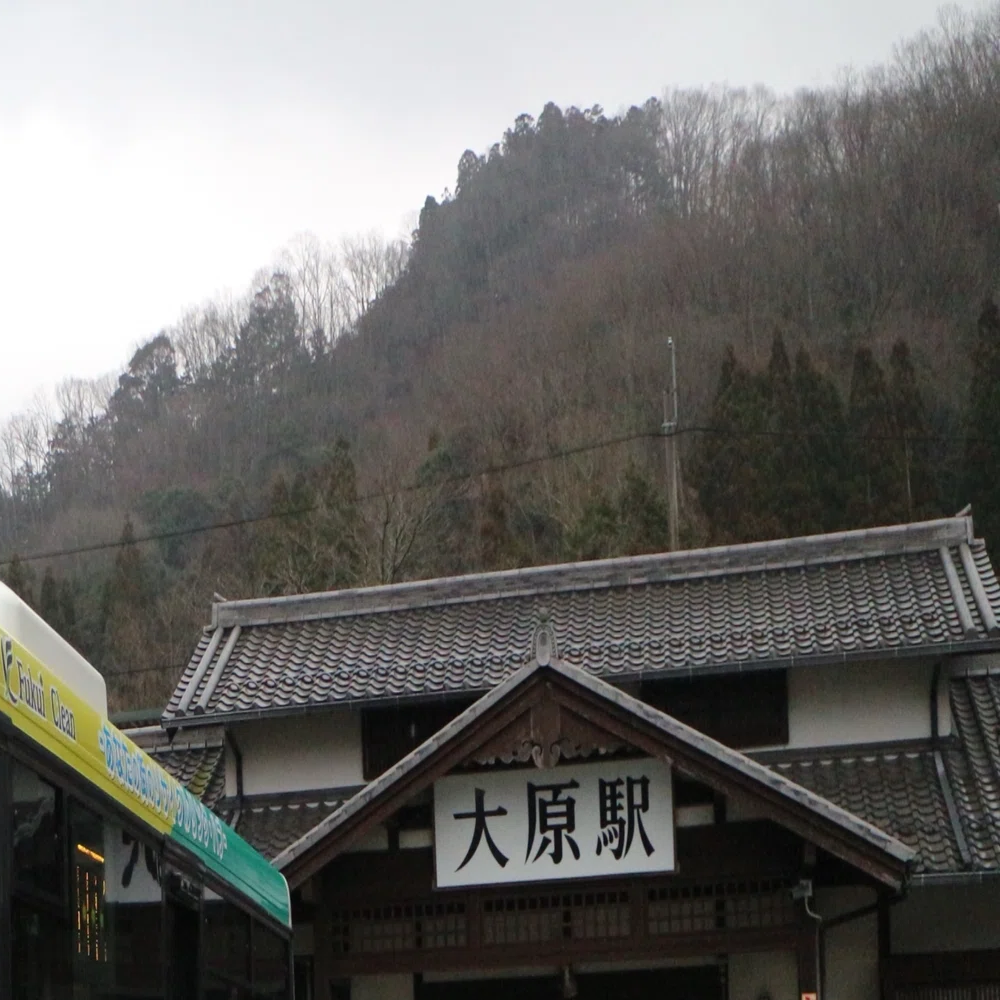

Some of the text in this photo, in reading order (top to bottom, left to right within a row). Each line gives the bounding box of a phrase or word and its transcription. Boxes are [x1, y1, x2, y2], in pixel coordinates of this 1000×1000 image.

[17, 660, 77, 741] Fukui Clean
[453, 774, 655, 872] 大原駅
